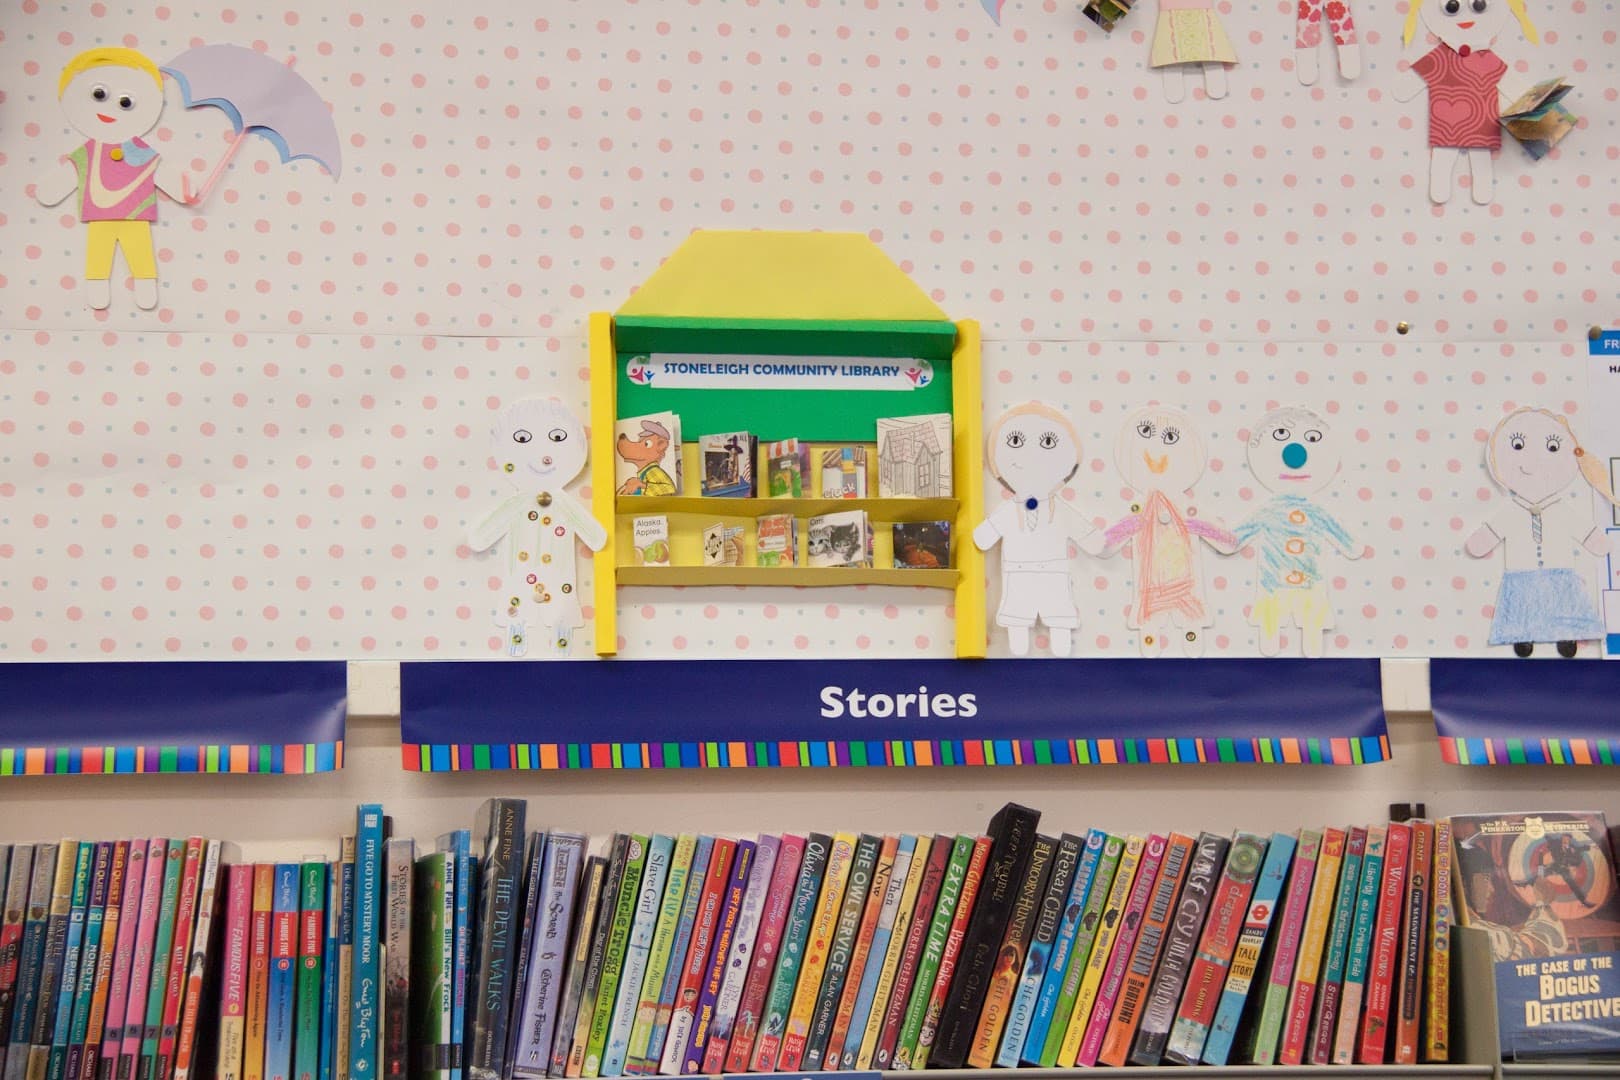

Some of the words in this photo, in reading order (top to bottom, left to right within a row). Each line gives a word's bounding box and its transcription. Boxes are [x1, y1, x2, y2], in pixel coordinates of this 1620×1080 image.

[663, 362, 749, 375] STONELEIGH
[752, 364, 838, 377] COMMUNITY
[841, 366, 900, 377] LIBRARY
[819, 685, 978, 718] Stories
[503, 807, 514, 836] ANNE
[365, 839, 375, 860] FIVE
[501, 838, 512, 862] FINE
[1415, 830, 1425, 862] GRANT
[1438, 823, 1449, 854] PENCIL
[79, 847, 89, 870] SEA
[98, 846, 109, 869] SEA
[114, 846, 126, 869] SEA
[365, 860, 375, 876] GO
[645, 853, 666, 887] Slave
[800, 841, 826, 878] Olivia
[857, 843, 877, 869] THE
[907, 856, 924, 885] Once
[972, 842, 988, 869] Morris
[1164, 845, 1187, 878] YOUNG
[1391, 847, 1403, 866] THE
[75, 870, 87, 904] QUEST
[95, 869, 107, 901] QUEST
[111, 869, 123, 901] QUEST
[343, 866, 352, 880] THE
[364, 878, 374, 891] TO
[391, 874, 400, 896] FIRST
[397, 865, 409, 905] STORIES
[445, 861, 453, 885] ANNE
[872, 861, 892, 898] Now
[922, 861, 943, 898] After
[1022, 849, 1050, 899] UNICORN
[1361, 861, 1378, 897] Liberty
[1386, 866, 1403, 898] WIND
[445, 891, 453, 910] FINE
[495, 875, 514, 905] THE
[640, 887, 658, 915] Girl
[797, 889, 815, 918] Movie
[846, 871, 867, 906] OWL
[884, 877, 903, 907] Then
[937, 862, 965, 918] EXTRA
[956, 870, 981, 921] Gleitzman
[1149, 878, 1176, 923] KNIGHTS
[1411, 890, 1420, 905] THE
[362, 891, 373, 934] MYSTERY
[391, 897, 400, 930] WORLD
[1207, 886, 1243, 954] dragonfly
[1360, 898, 1369, 913] and
[255, 917, 266, 938] FAMOUS
[279, 918, 290, 940] FAMOUS
[307, 916, 317, 939] FAMOUS
[490, 906, 511, 953] DEVIL
[545, 902, 565, 940] SCARAB
[1407, 906, 1419, 962] MAGNIFICENT
[229, 928, 244, 974] FAMOUS
[255, 940, 265, 955] FIVE
[279, 942, 289, 956] FIVE
[307, 940, 316, 954] FIVE
[362, 935, 372, 965] MOOR
[390, 932, 399, 953] WAR
[444, 927, 453, 953] Bill's
[596, 932, 607, 945] Day
[604, 929, 625, 976] Trogg
[829, 908, 858, 973] SERVICE
[907, 917, 926, 961] MORRIS
[924, 920, 948, 963] TIME
[943, 929, 965, 958] Pizza
[1130, 924, 1163, 976] MERLIN
[1165, 936, 1191, 971] JULIA
[1354, 926, 1366, 955] Dream
[1376, 926, 1394, 978] WILLOWS
[64, 945, 79, 992] NEPHRO
[82, 944, 97, 992] MONOTH
[443, 957, 451, 980] New
[1239, 947, 1257, 961] TALL
[1329, 951, 1342, 972] Pony
[1351, 957, 1364, 978] Ride
[1515, 963, 1537, 977] THE
[1541, 960, 1569, 974] CASE
[1573, 958, 1587, 971] OF
[1591, 956, 1613, 970] THE
[486, 958, 506, 1012] WALKS
[628, 960, 641, 989] JACKIE
[917, 969, 932, 998] MORRIS
[933, 959, 954, 987] Cake
[1231, 964, 1254, 977] STORY
[228, 973, 240, 1001] FIVE
[356, 977, 373, 1006] Enid
[442, 983, 450, 1013] Frock
[536, 968, 554, 1010] Catherine
[601, 979, 614, 1007] Janet
[720, 970, 735, 1011] GARDNER
[730, 985, 740, 1003] LYN
[743, 970, 762, 1010] GARDNER
[754, 985, 766, 1002] LYN
[825, 974, 839, 998] ALAN
[836, 965, 860, 1030] GLEITZMAN
[868, 969, 891, 1033] GLEITZMAN
[886, 961, 913, 1027] GLEITZMAN
[992, 976, 1010, 1001] CHE
[1021, 976, 1037, 1002] CHE
[1150, 974, 1180, 1027] GOLDING
[1298, 984, 1310, 1010] STACY
[1324, 984, 1336, 1010] STACY
[1539, 974, 1600, 1001] BOGUS
[620, 991, 635, 1027] FRENCH
[816, 999, 833, 1036] GARNER
[905, 997, 924, 1042] GLEITZMAN
[1117, 984, 1140, 1025] GOLDING
[1524, 996, 1620, 1028] DETECTIVE
[356, 1007, 373, 1049] Blyton
[530, 1012, 548, 1046] FISHER
[592, 1008, 607, 1042] Foxley
[977, 1003, 1001, 1052] GOLDEN
[1006, 1004, 1029, 1053] GOLDEN
[1291, 1010, 1306, 1043] GREGG
[1319, 1010, 1333, 1045] GREGG
[484, 1030, 494, 1068] DOUBLEDAY
